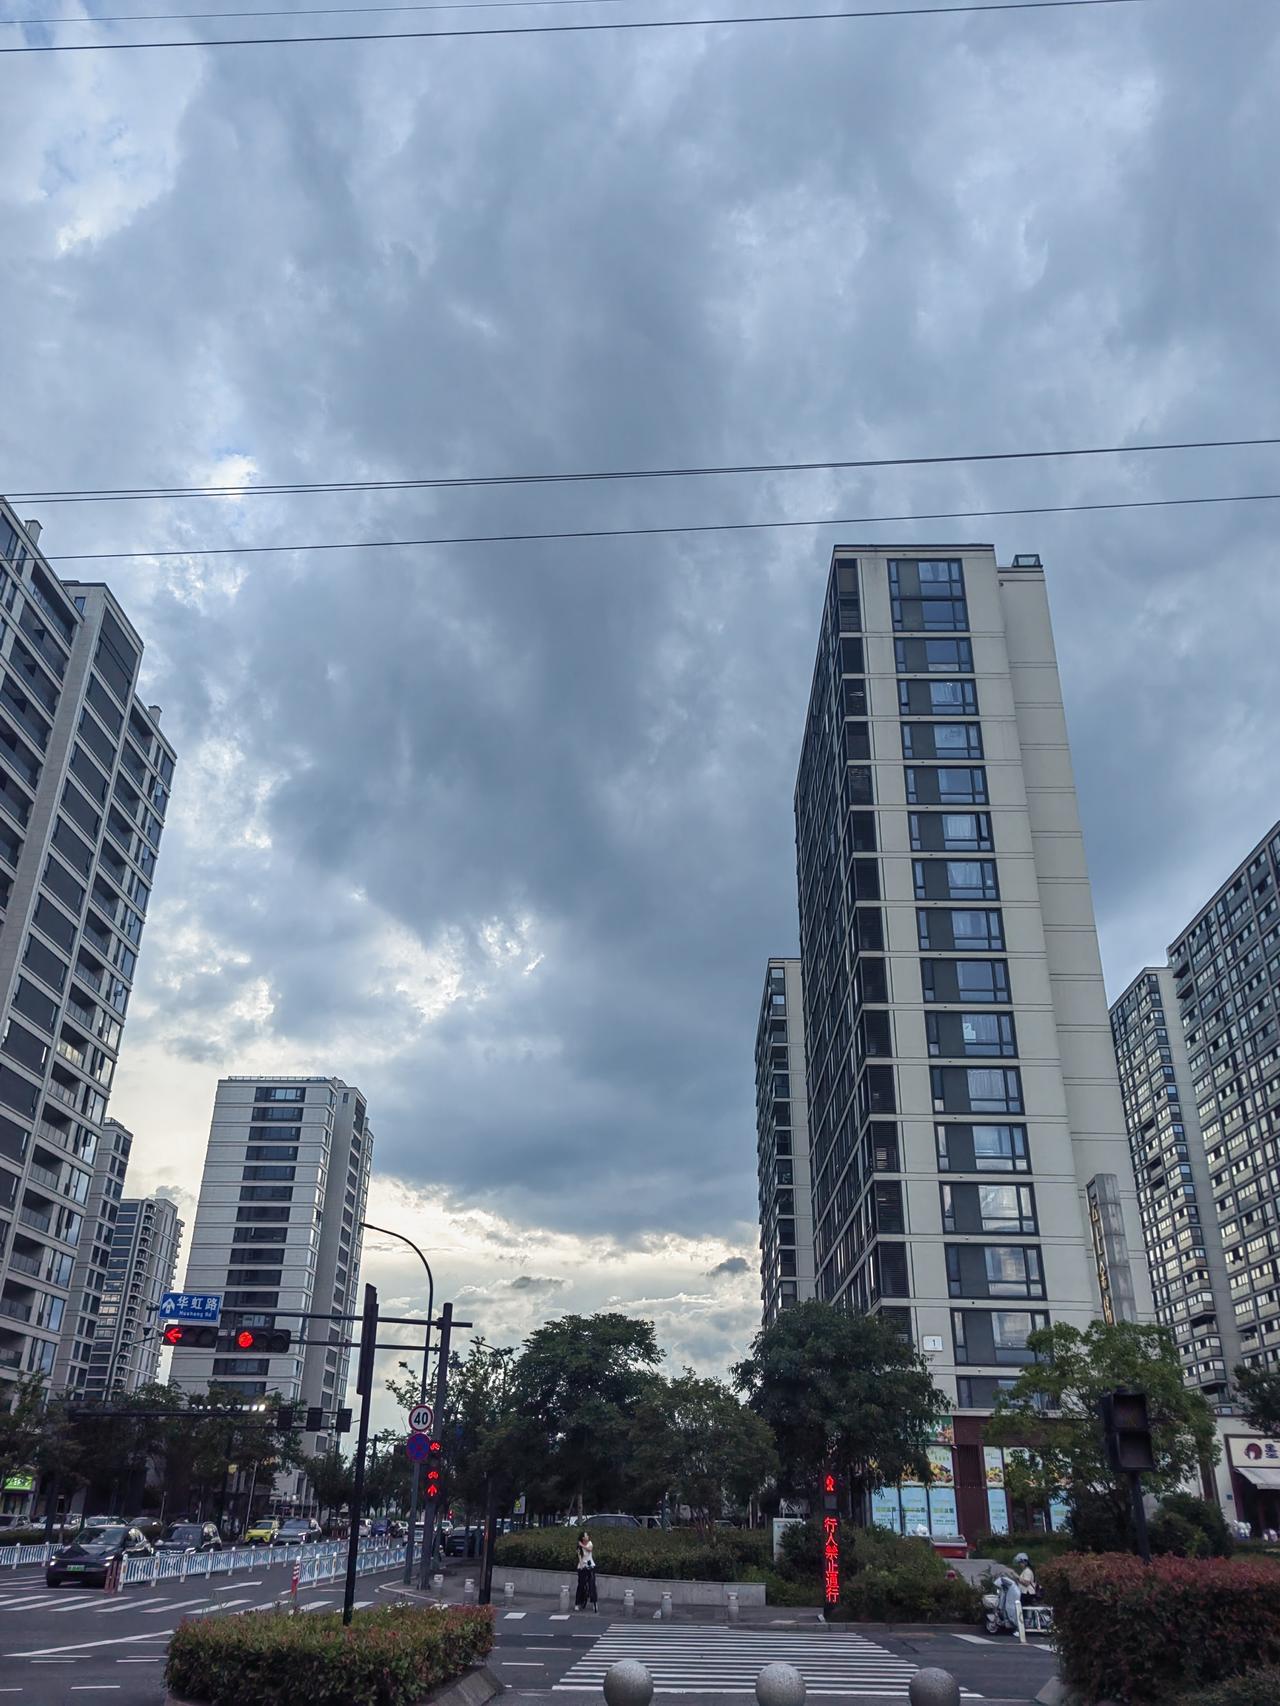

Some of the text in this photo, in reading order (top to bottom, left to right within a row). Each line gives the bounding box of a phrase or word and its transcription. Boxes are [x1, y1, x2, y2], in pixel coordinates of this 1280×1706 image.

[176, 1295, 218, 1311] 华虹路
[413, 1411, 429, 1425] 40
[824, 1517, 839, 1603] 行人禁止通行
